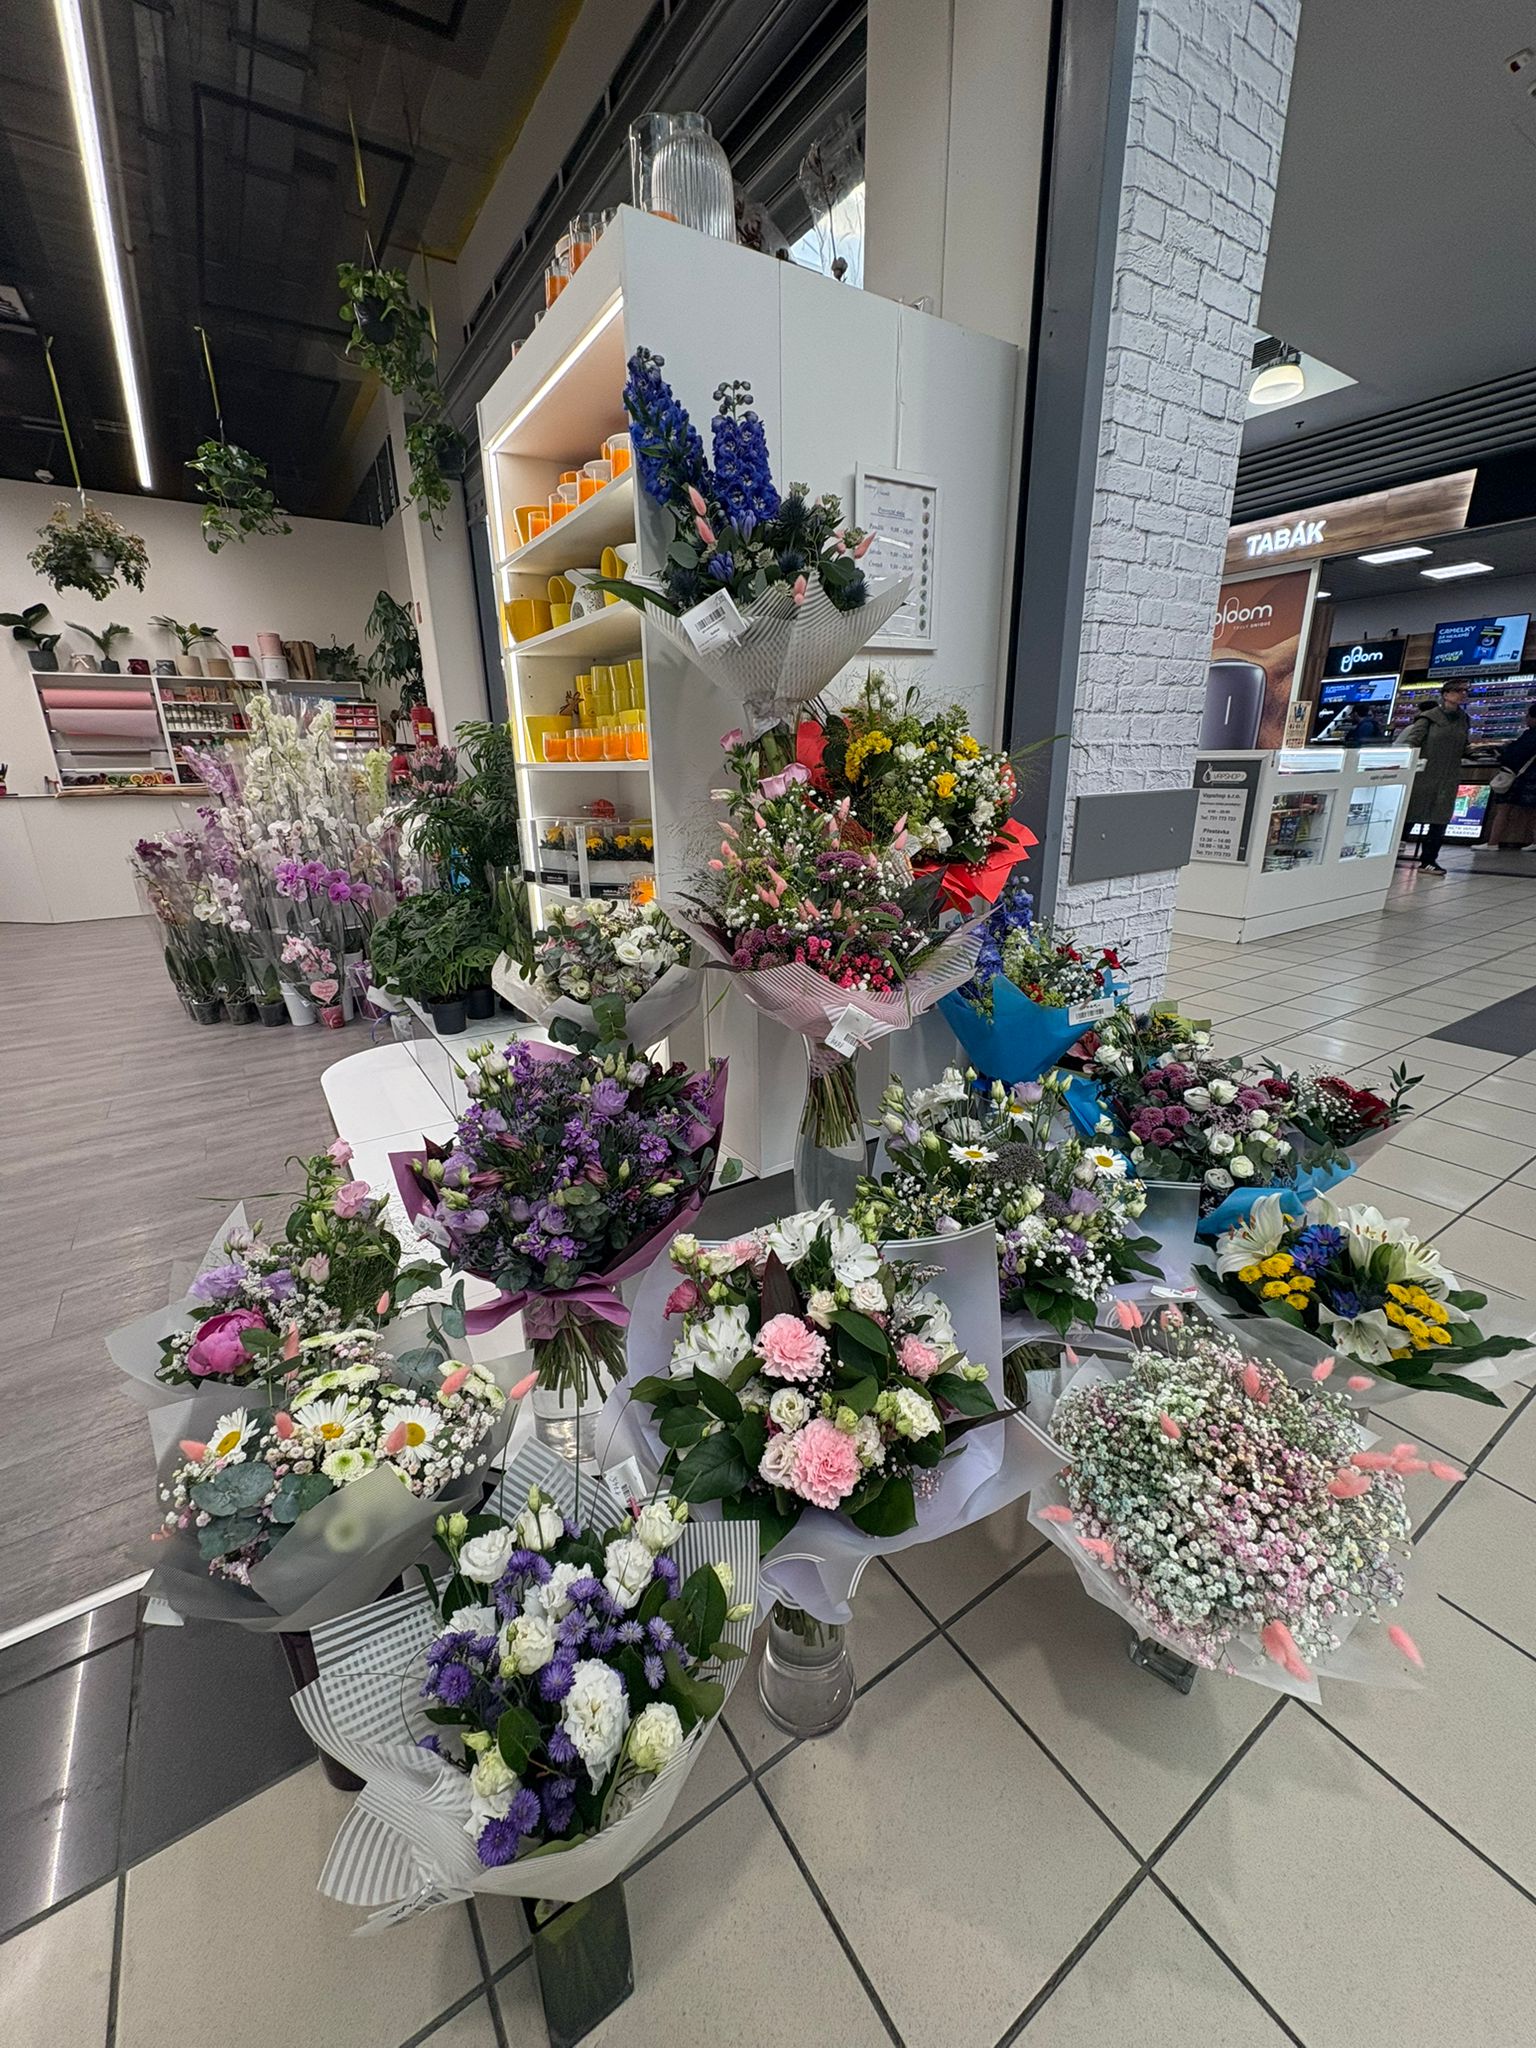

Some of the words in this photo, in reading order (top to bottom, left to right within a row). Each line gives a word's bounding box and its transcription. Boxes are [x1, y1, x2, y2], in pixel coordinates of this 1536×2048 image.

[1246, 520, 1327, 556] TABÁK
[1439, 625, 1477, 635] CAMELKY
[1340, 645, 1384, 673] ploom
